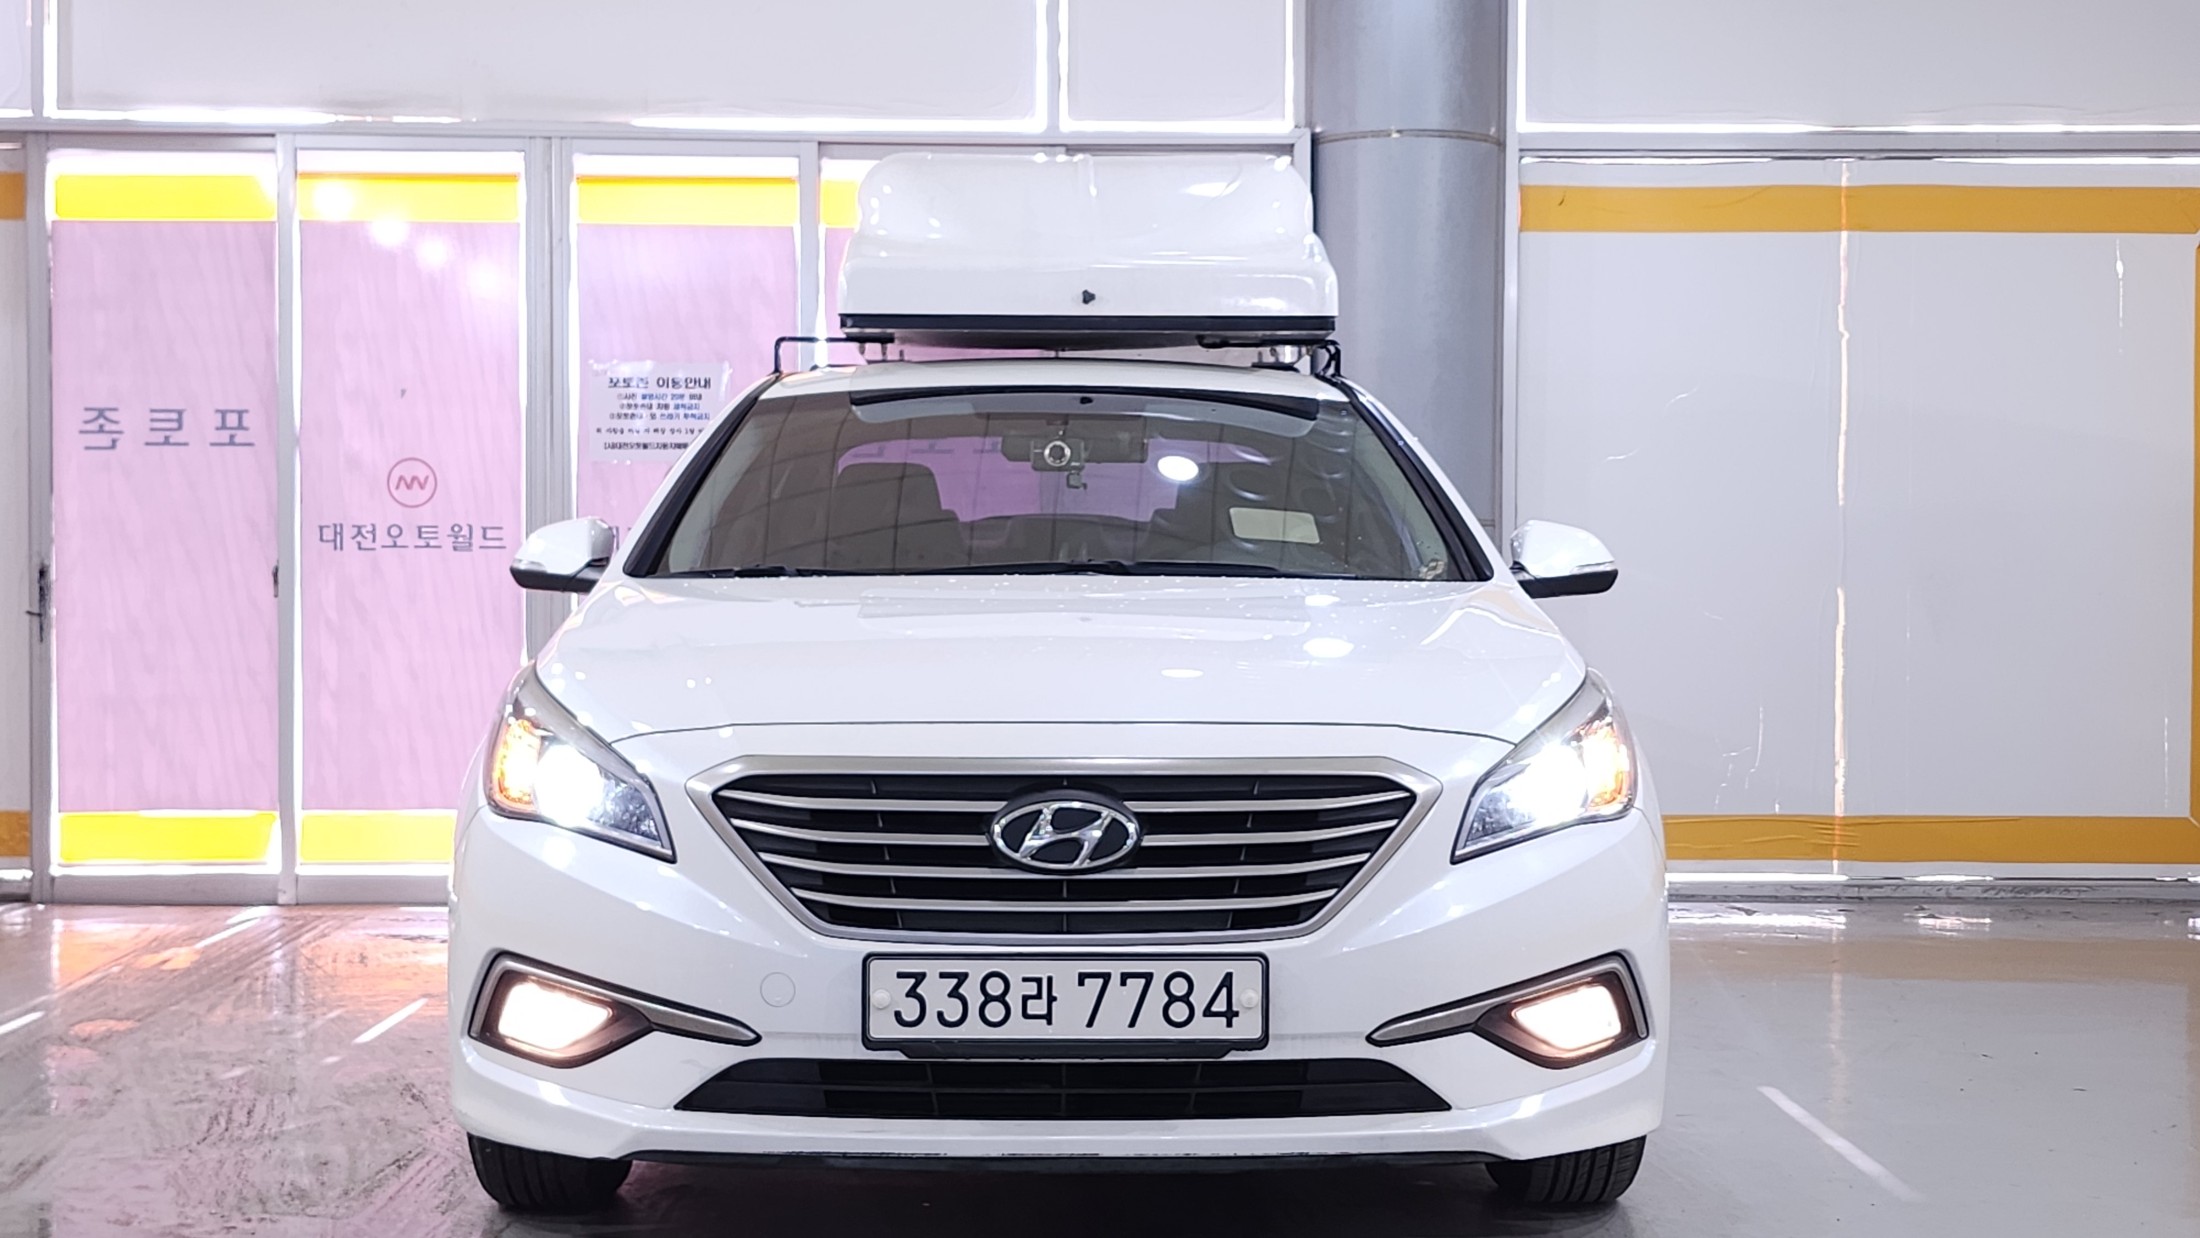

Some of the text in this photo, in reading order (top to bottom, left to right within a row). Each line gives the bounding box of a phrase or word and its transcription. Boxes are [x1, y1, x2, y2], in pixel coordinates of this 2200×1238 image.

[318, 523, 507, 552] 대전오토월드
[893, 970, 1240, 1028] 338라 7784
